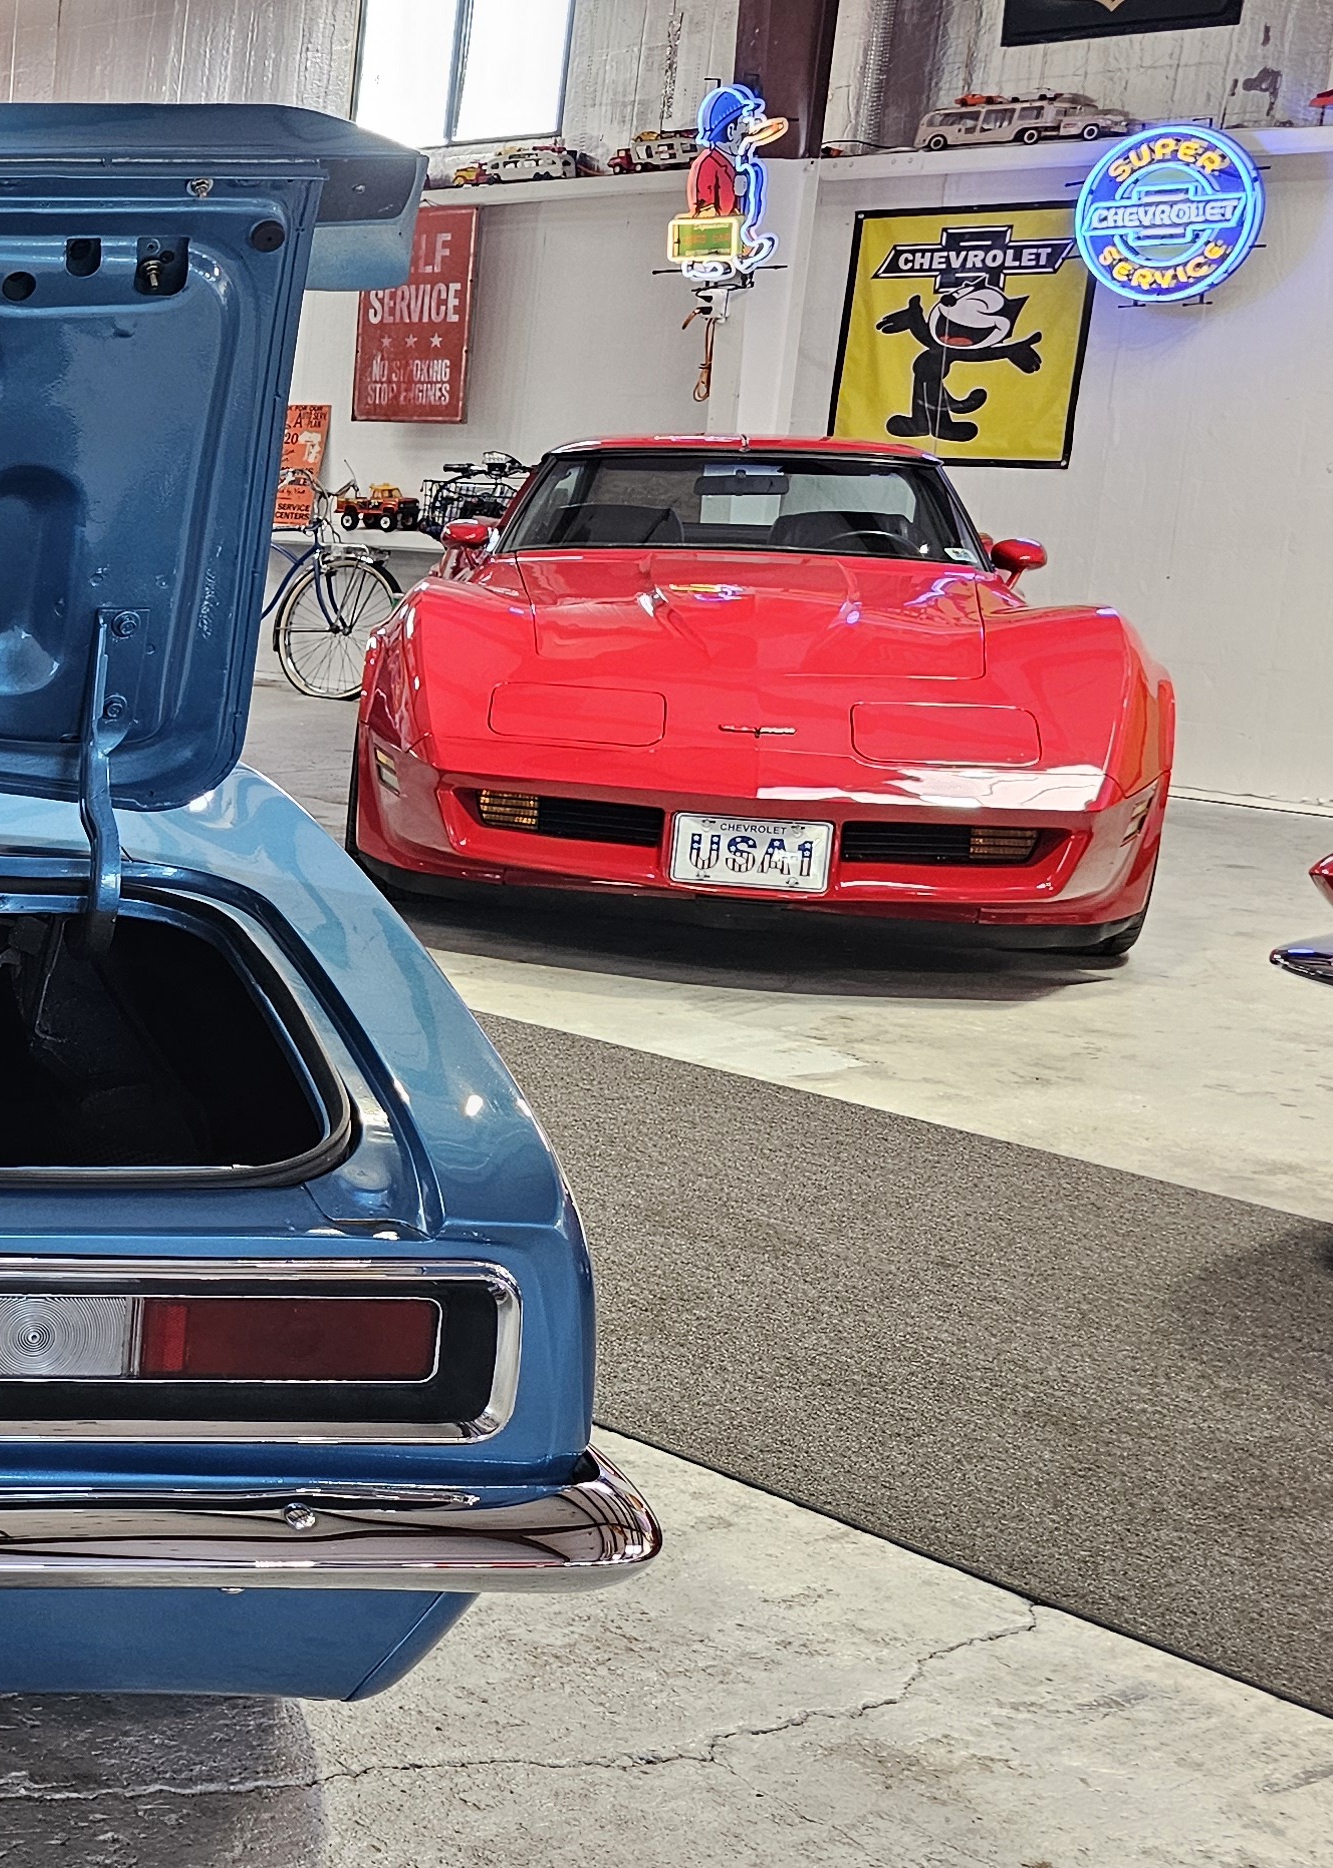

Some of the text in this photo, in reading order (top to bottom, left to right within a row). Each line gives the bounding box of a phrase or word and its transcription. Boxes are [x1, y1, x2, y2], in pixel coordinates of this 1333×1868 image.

[1107, 138, 1229, 183] SUPER
[1091, 200, 1238, 230] CHEVROLET
[898, 247, 1052, 271] CHEVROLET
[1098, 239, 1233, 292] SERVICE
[368, 283, 462, 325] SERVICE
[367, 384, 397, 406] STOP
[275, 511, 310, 520] CENTERS
[277, 503, 311, 512] SERVICE
[719, 822, 787, 835] CHEVROLET
